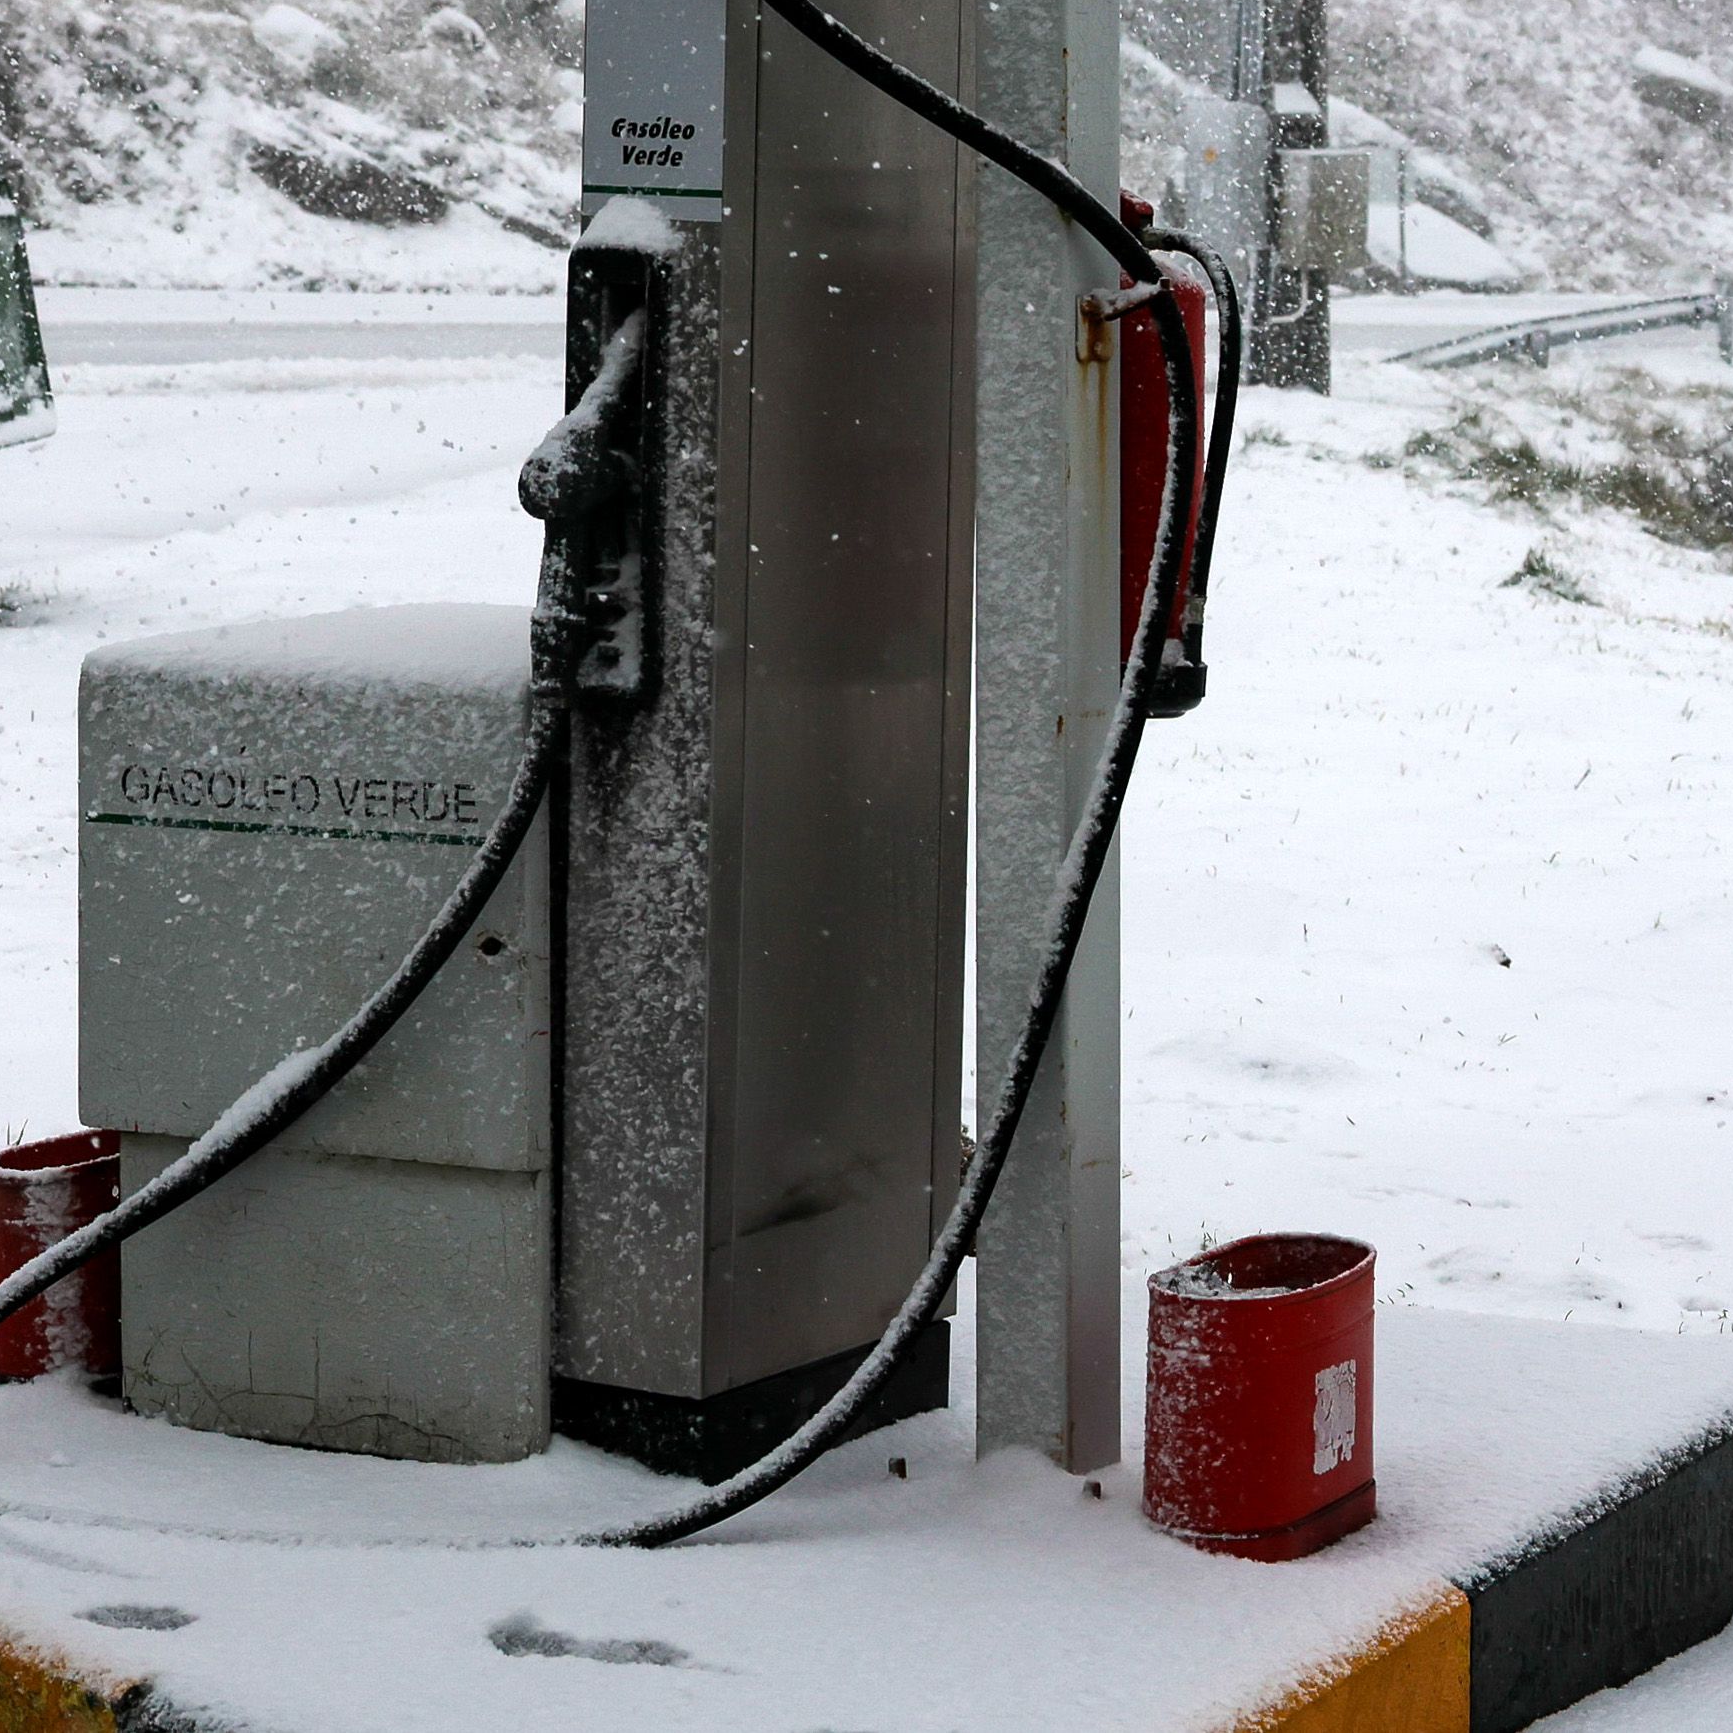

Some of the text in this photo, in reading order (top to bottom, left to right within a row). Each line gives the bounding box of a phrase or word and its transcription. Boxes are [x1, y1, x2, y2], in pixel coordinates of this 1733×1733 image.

[610, 116, 696, 141] Gasóleo
[622, 143, 684, 167] Verde
[333, 777, 479, 824] VERDE
